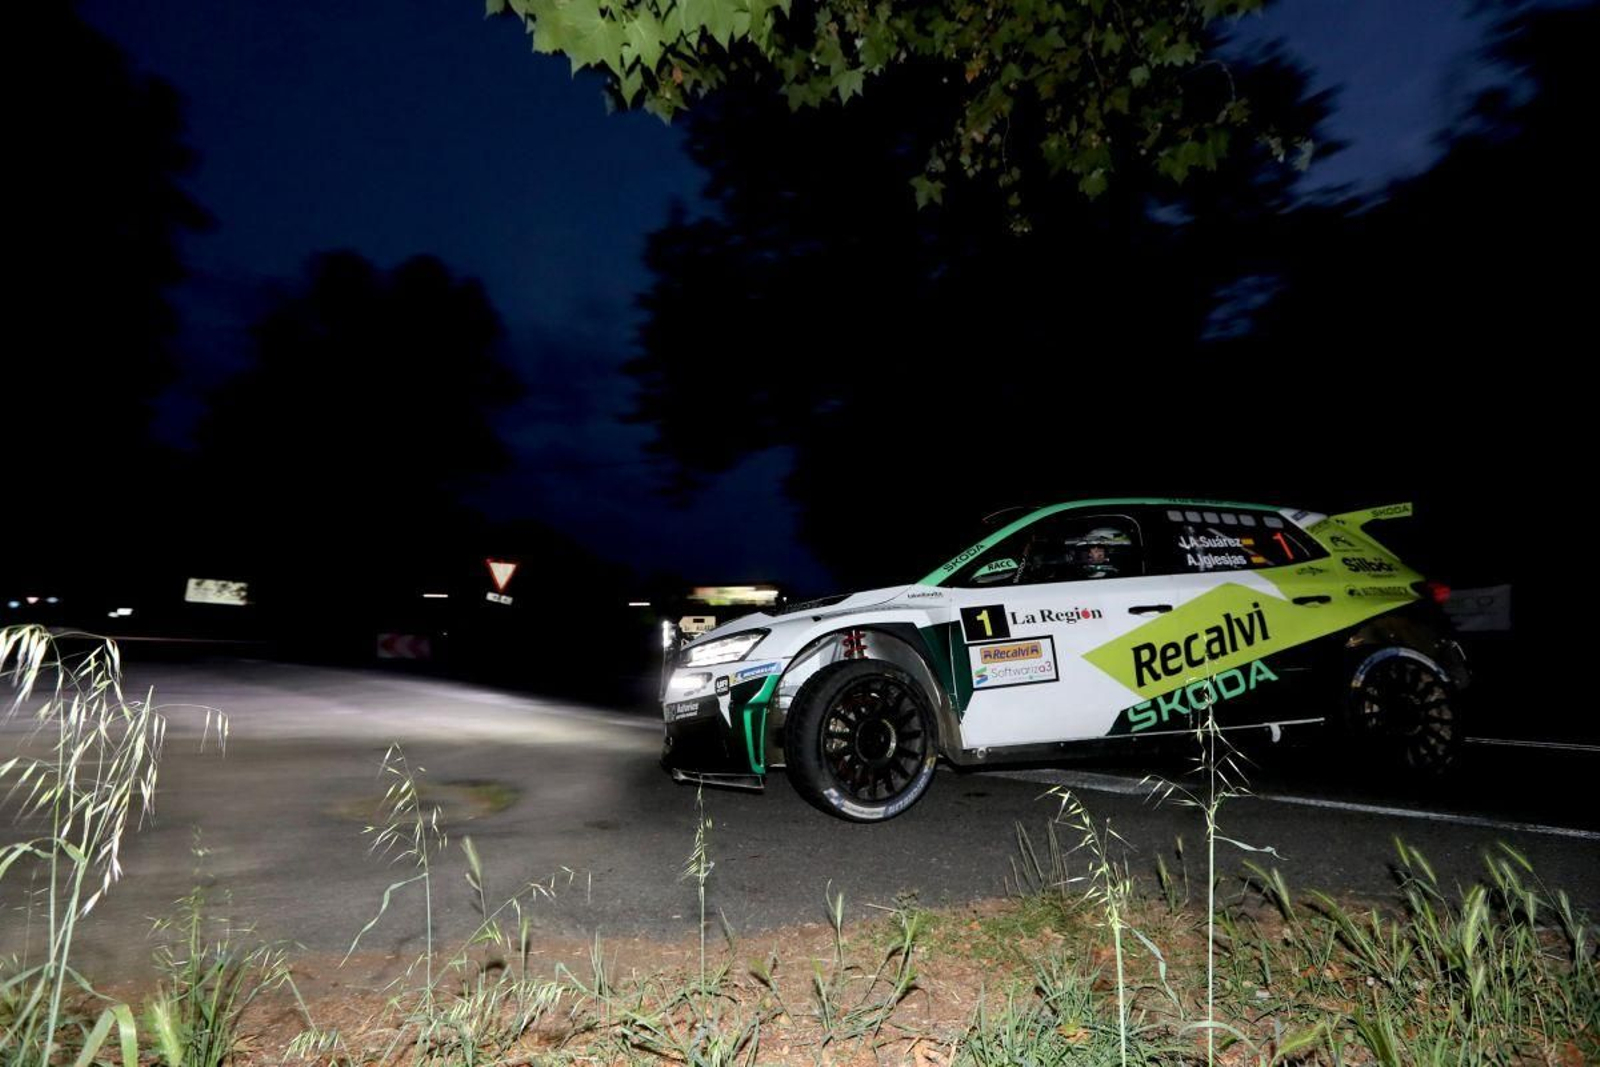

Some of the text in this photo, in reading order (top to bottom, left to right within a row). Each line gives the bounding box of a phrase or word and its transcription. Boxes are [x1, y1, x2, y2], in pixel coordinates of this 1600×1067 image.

[1272, 532, 1294, 560] 1
[987, 559, 1012, 571] RACC
[976, 609, 993, 637] 1
[1009, 611, 1037, 625] La
[993, 646, 1030, 660] Recalvi
[1131, 602, 1271, 688] Recalvi
